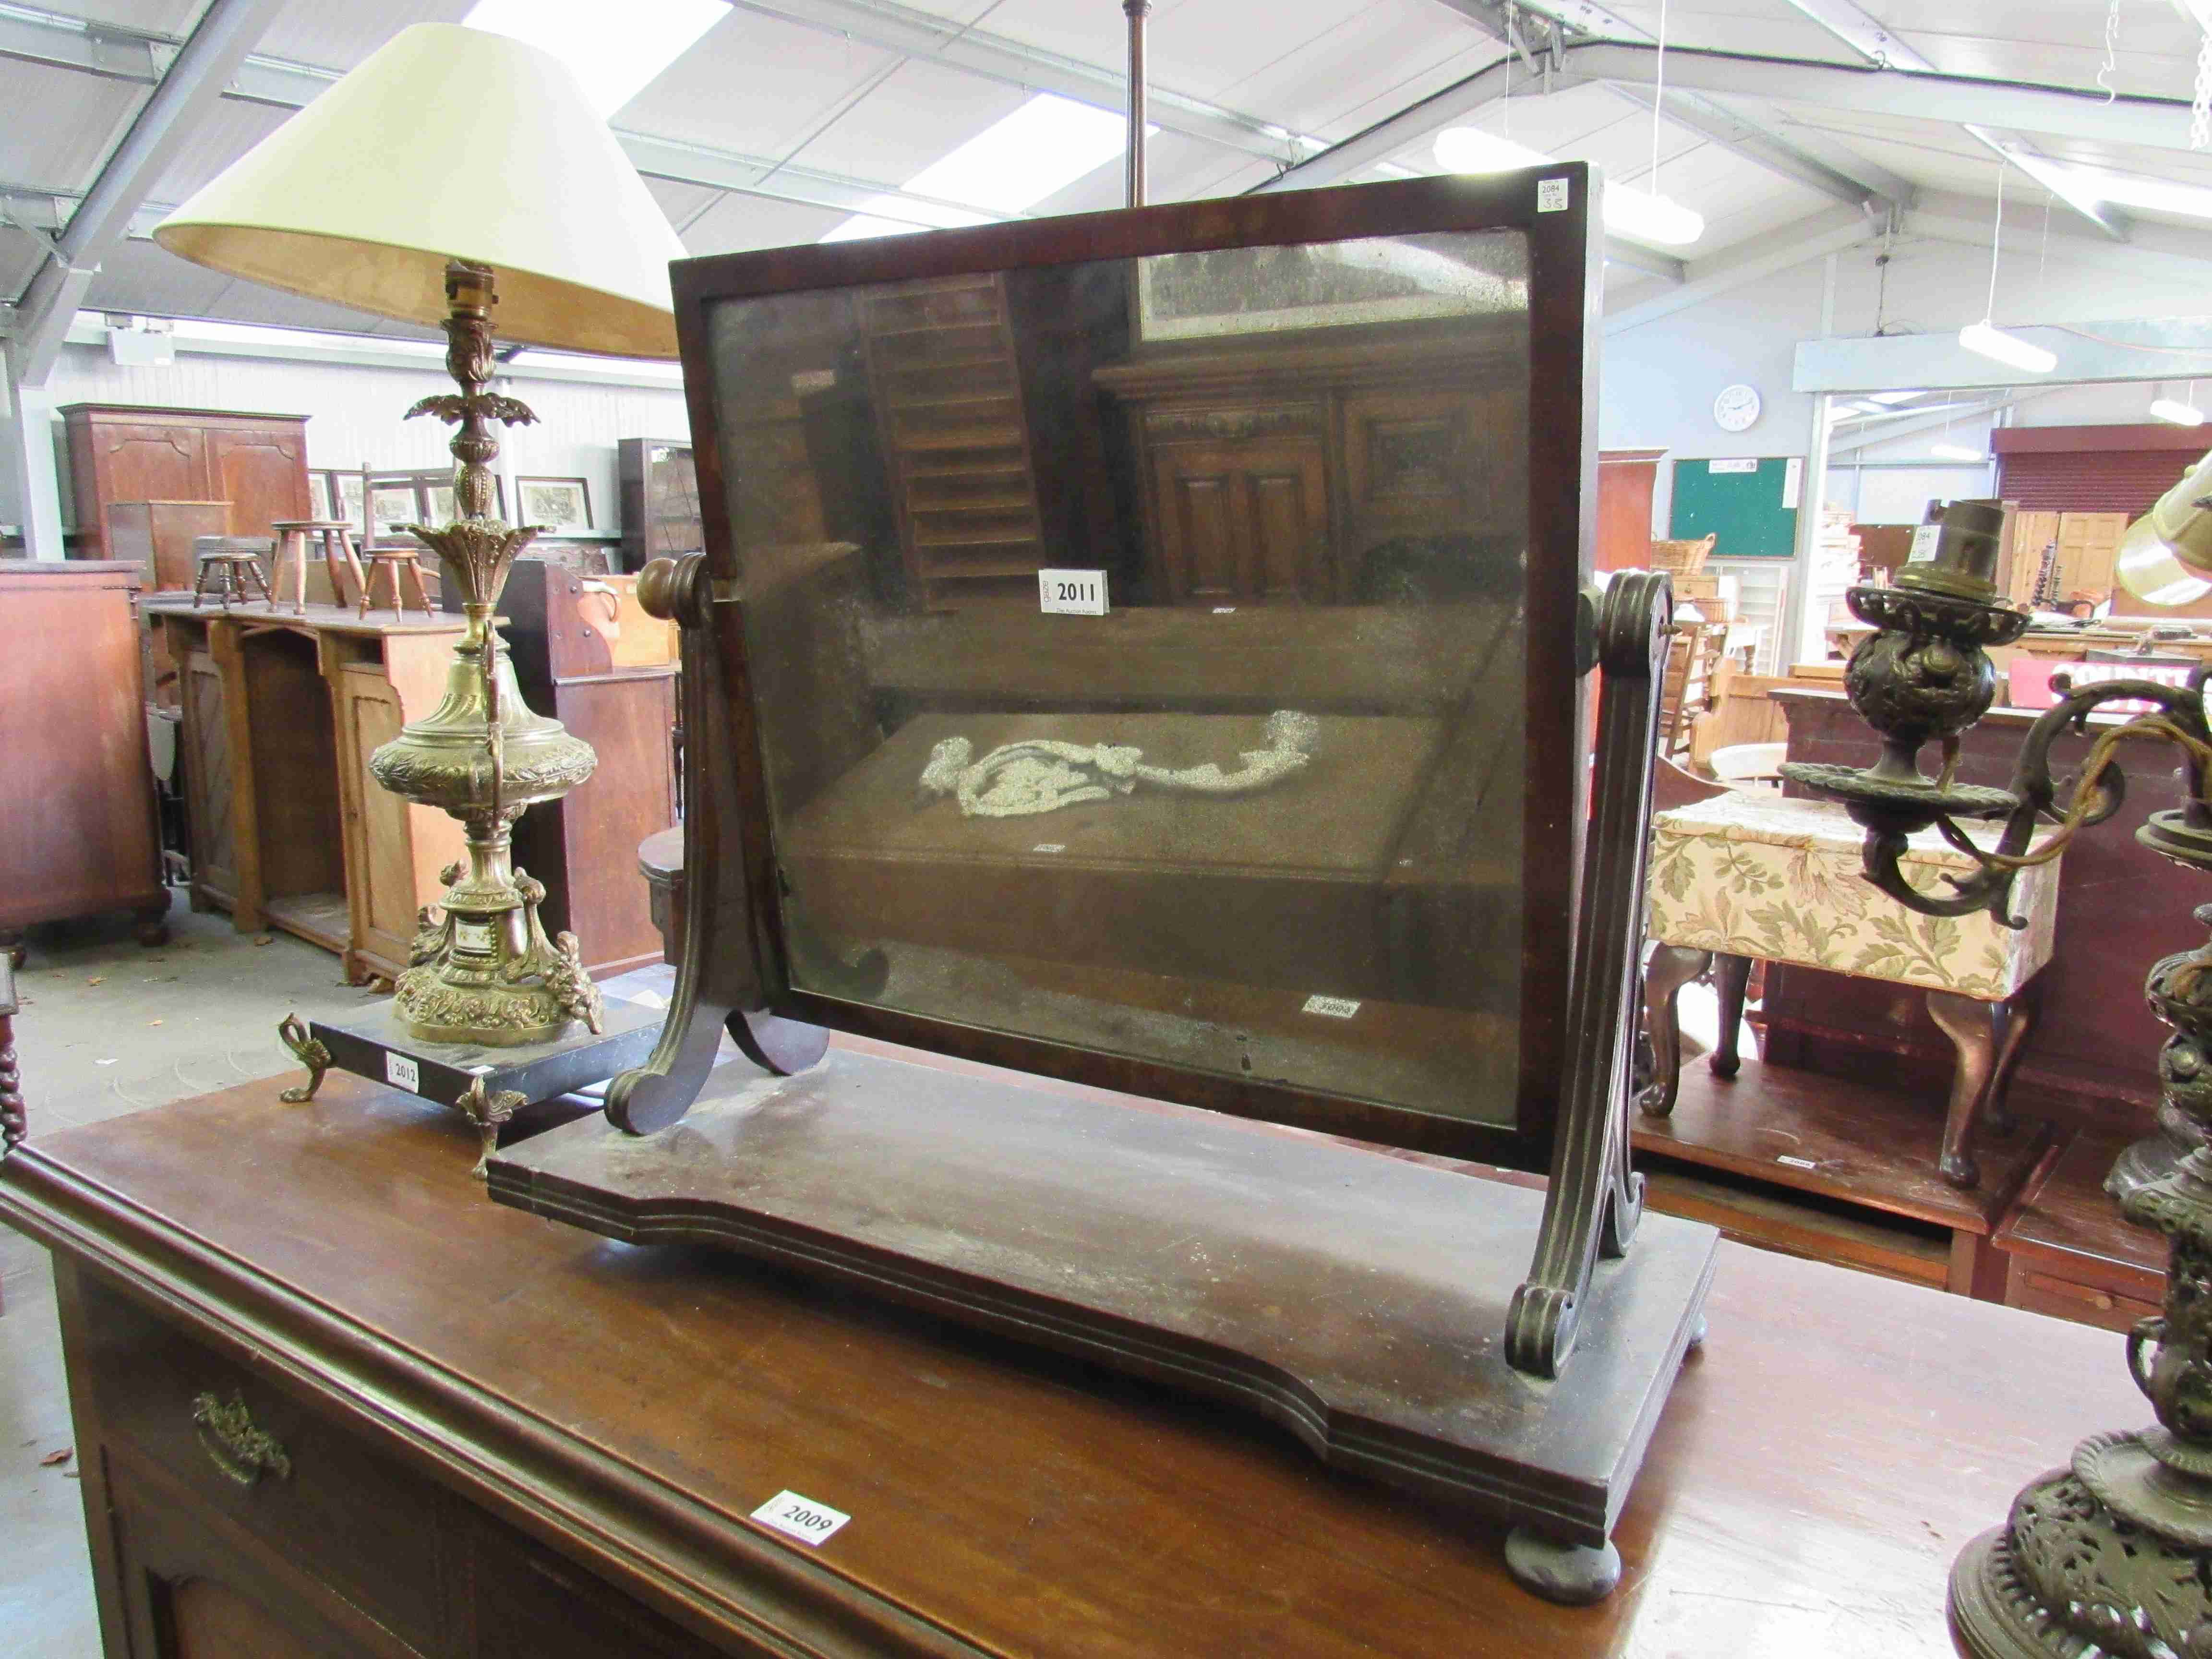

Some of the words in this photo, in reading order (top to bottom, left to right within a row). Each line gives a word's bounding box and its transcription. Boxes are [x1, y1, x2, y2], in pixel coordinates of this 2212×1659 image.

[1542, 185, 1560, 193] 2084
[1058, 583, 1094, 601] 2011
[396, 1063, 416, 1081] 2012
[782, 1505, 833, 1532] 2009
